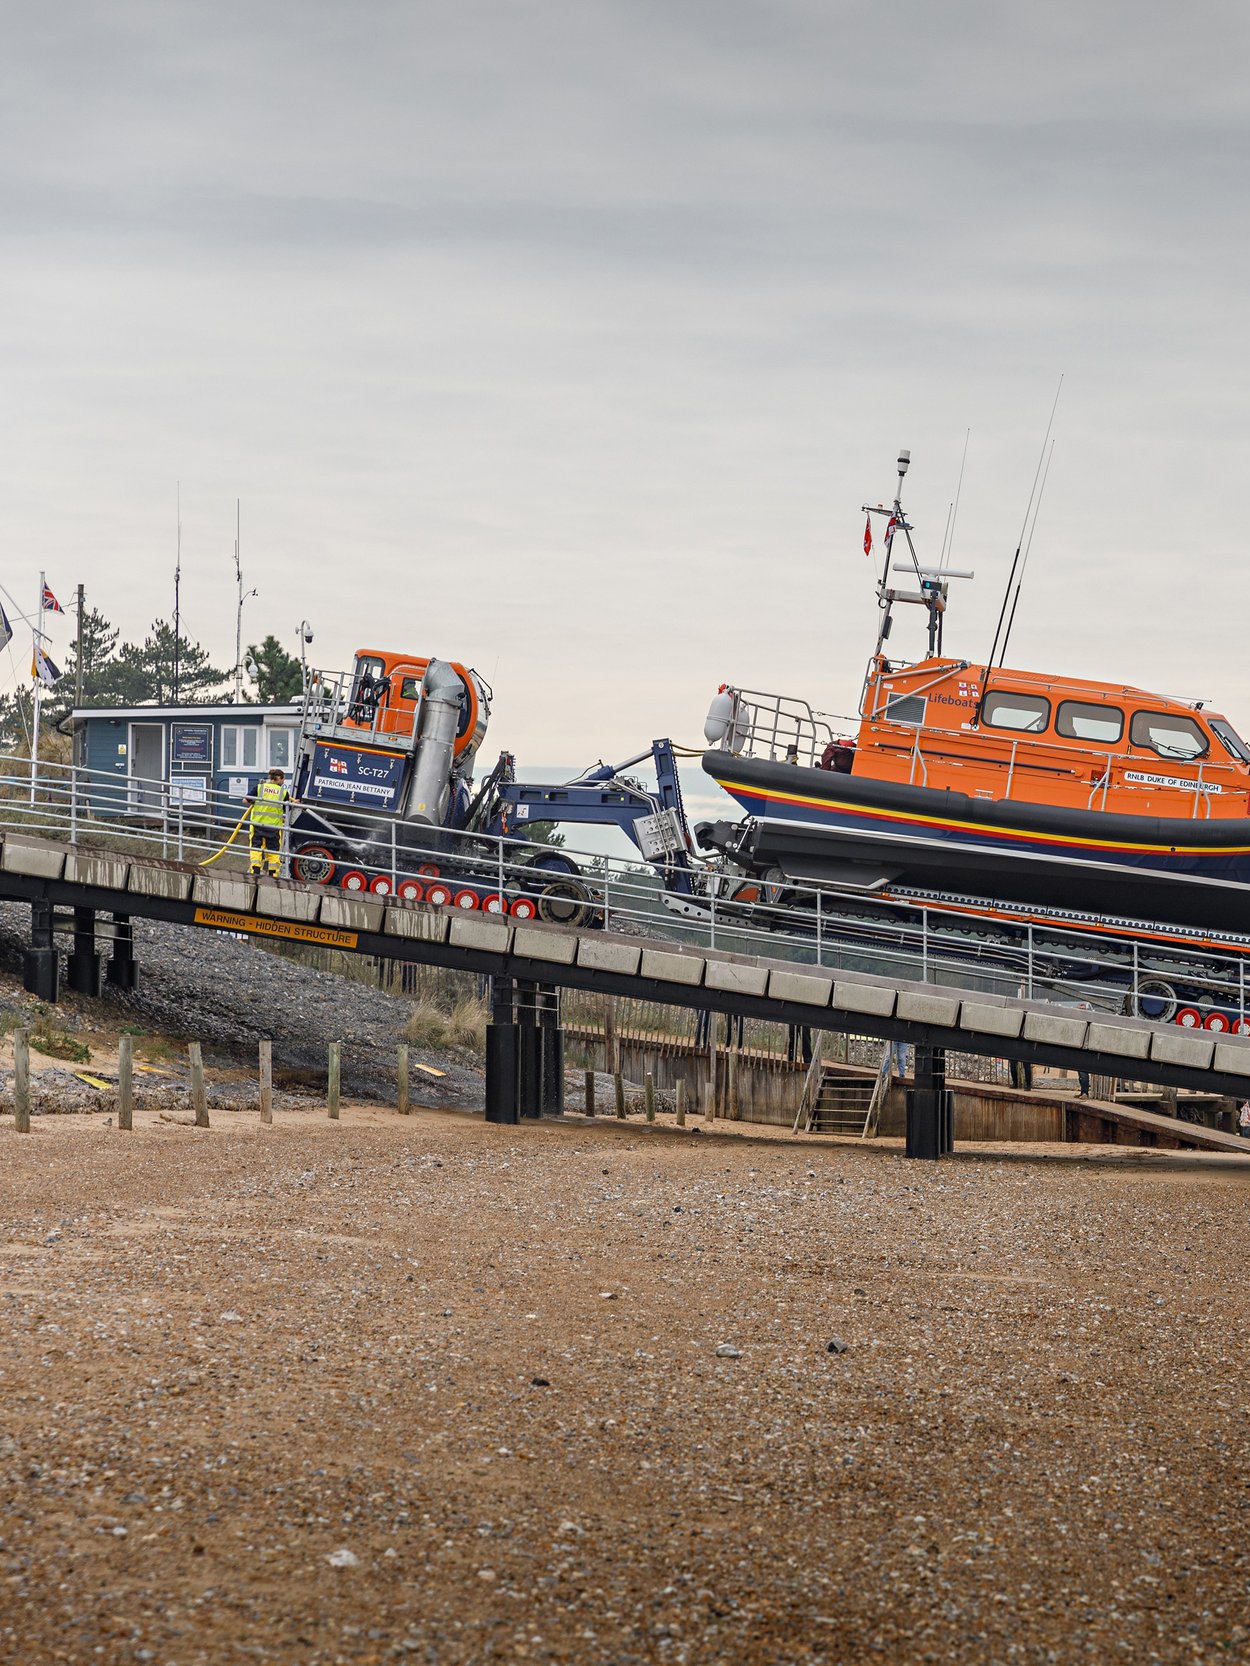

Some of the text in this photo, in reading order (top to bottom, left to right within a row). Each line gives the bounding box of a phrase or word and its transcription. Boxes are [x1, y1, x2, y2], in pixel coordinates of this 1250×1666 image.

[928, 693, 979, 709] Lifeboats
[358, 766, 389, 779] SC-T27
[318, 778, 391, 795] PATRICIA JEAN BETTANY
[1127, 772, 1219, 792] RNLB DUKE OF EDINURGH
[263, 787, 280, 795] RNLI
[202, 911, 246, 927] WARNING
[255, 921, 291, 935] HIDDEN
[294, 928, 351, 944] STRUCTURE
